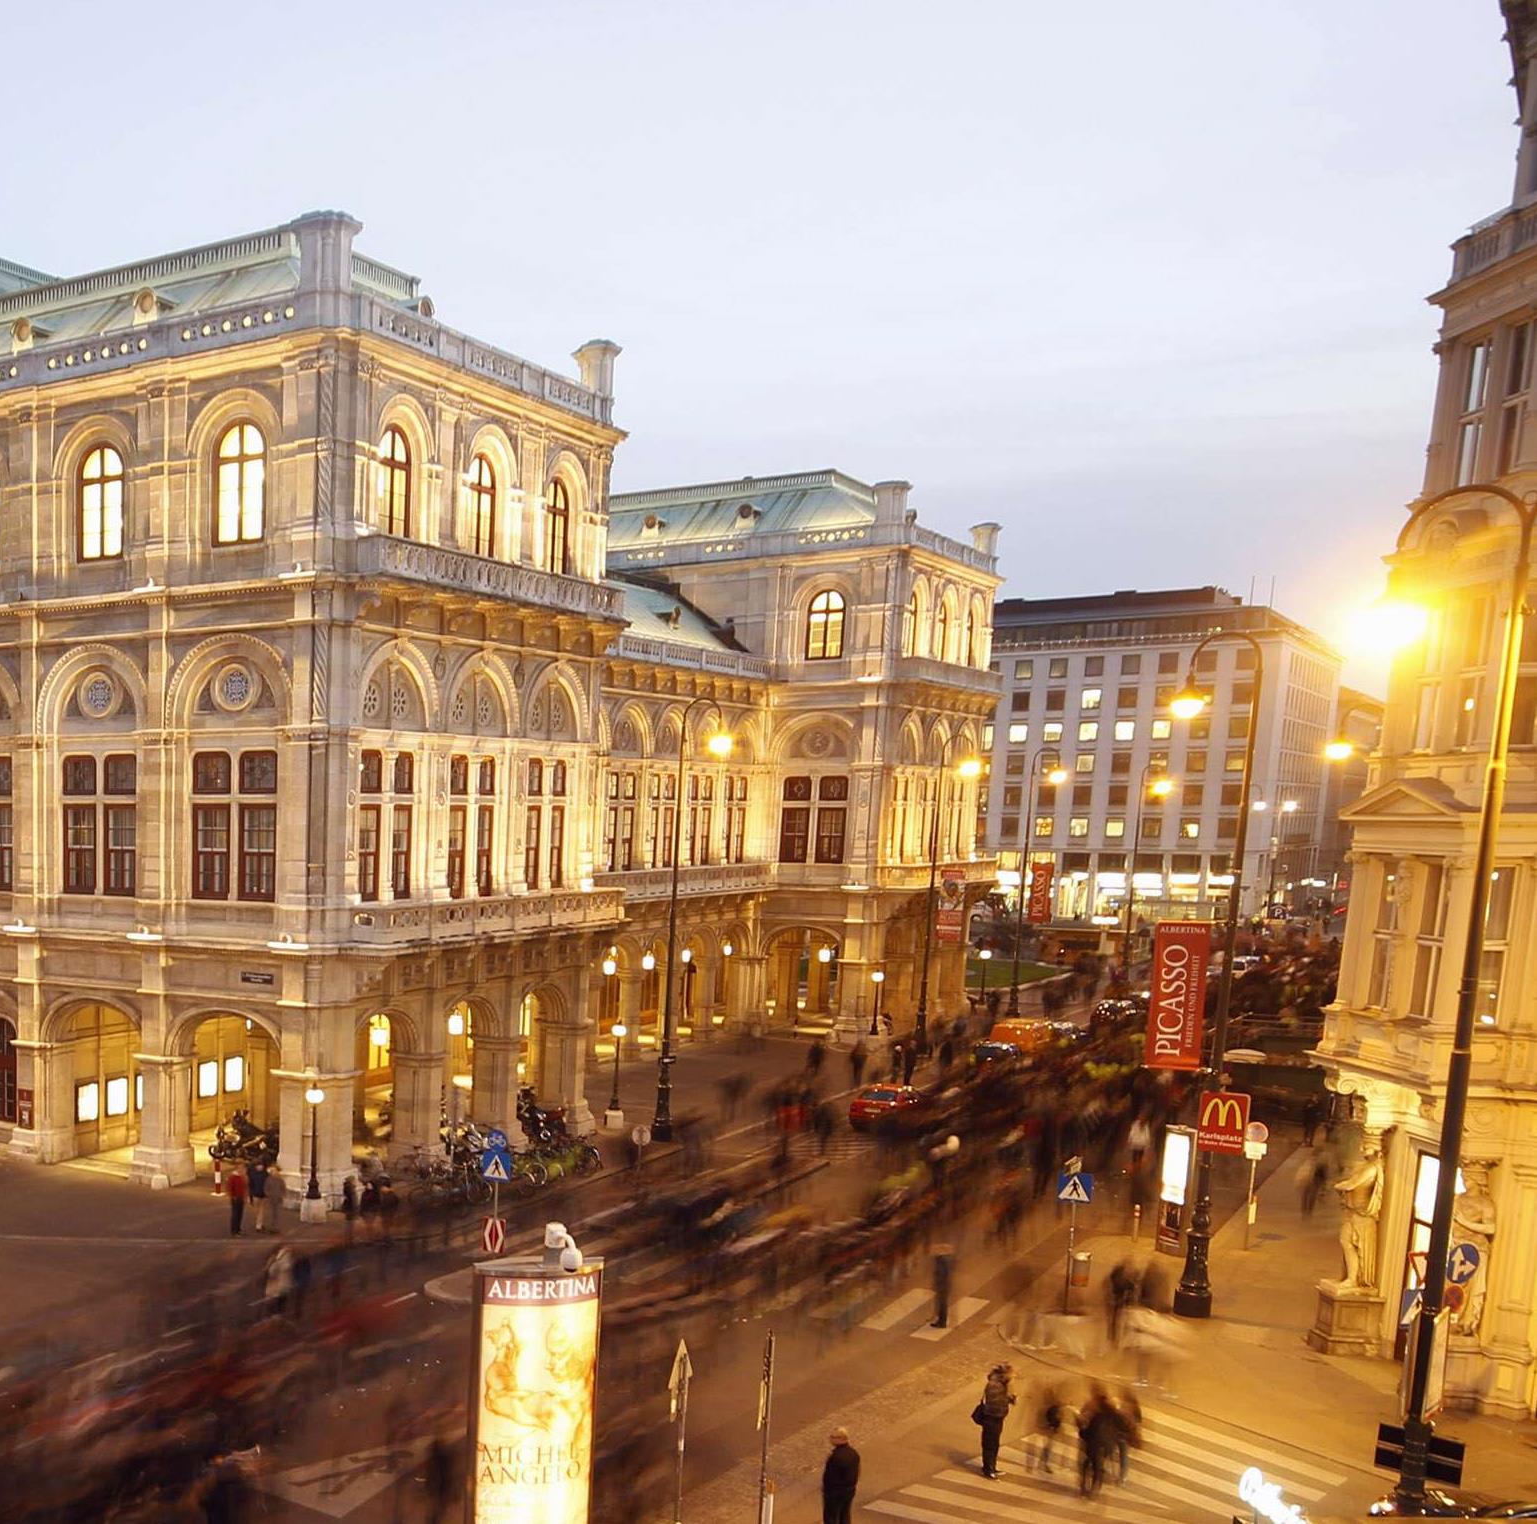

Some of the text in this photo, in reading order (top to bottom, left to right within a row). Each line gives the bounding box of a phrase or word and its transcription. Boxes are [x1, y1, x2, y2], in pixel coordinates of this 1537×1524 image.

[1032, 871, 1045, 916] PICASSO
[1160, 926, 1206, 934] ALBERTINA
[1155, 945, 1189, 1056] PICASSO
[1188, 992, 1197, 1011] UND
[1199, 1131, 1242, 1142] Karlsplatz
[488, 1276, 596, 1300] ALBERTINA
